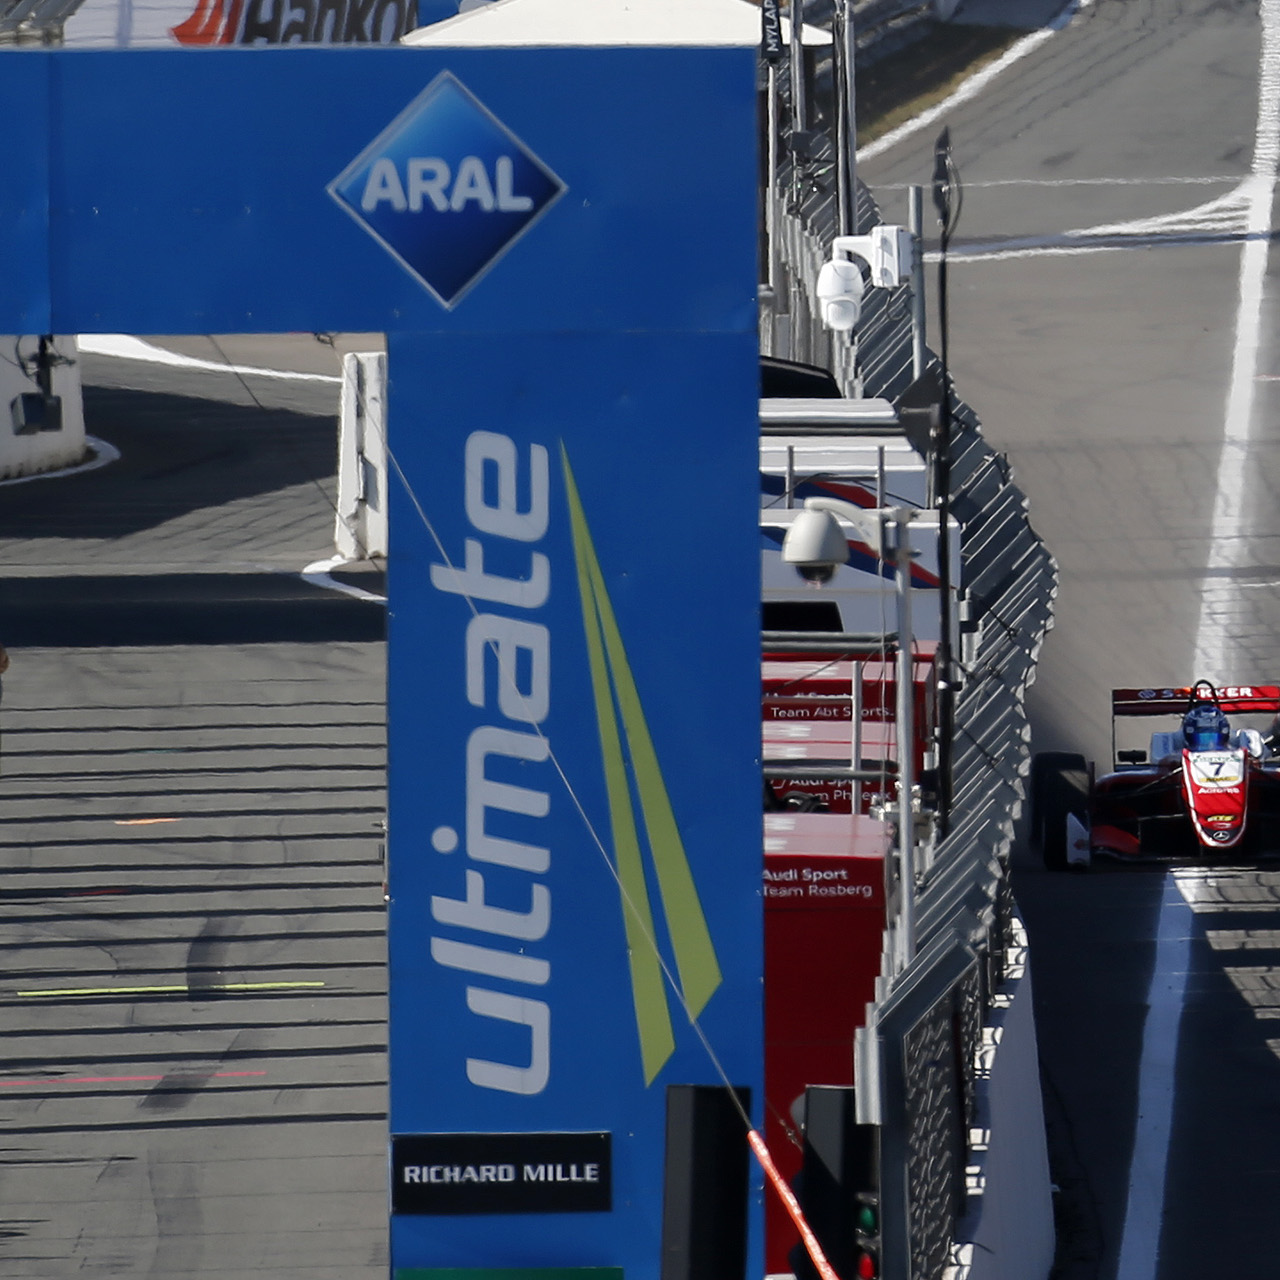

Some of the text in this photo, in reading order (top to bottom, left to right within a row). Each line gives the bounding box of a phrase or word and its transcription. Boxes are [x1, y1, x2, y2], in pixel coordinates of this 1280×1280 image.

[360, 155, 535, 213] ARAL
[771, 707, 810, 718] Team
[813, 706, 838, 717] Abt
[429, 430, 551, 1096] ultimate
[1208, 762, 1225, 776] 7
[763, 868, 848, 883] Audi Sport
[763, 883, 872, 897] Team Rosberg
[403, 1162, 600, 1185] RICHARD MILLE
